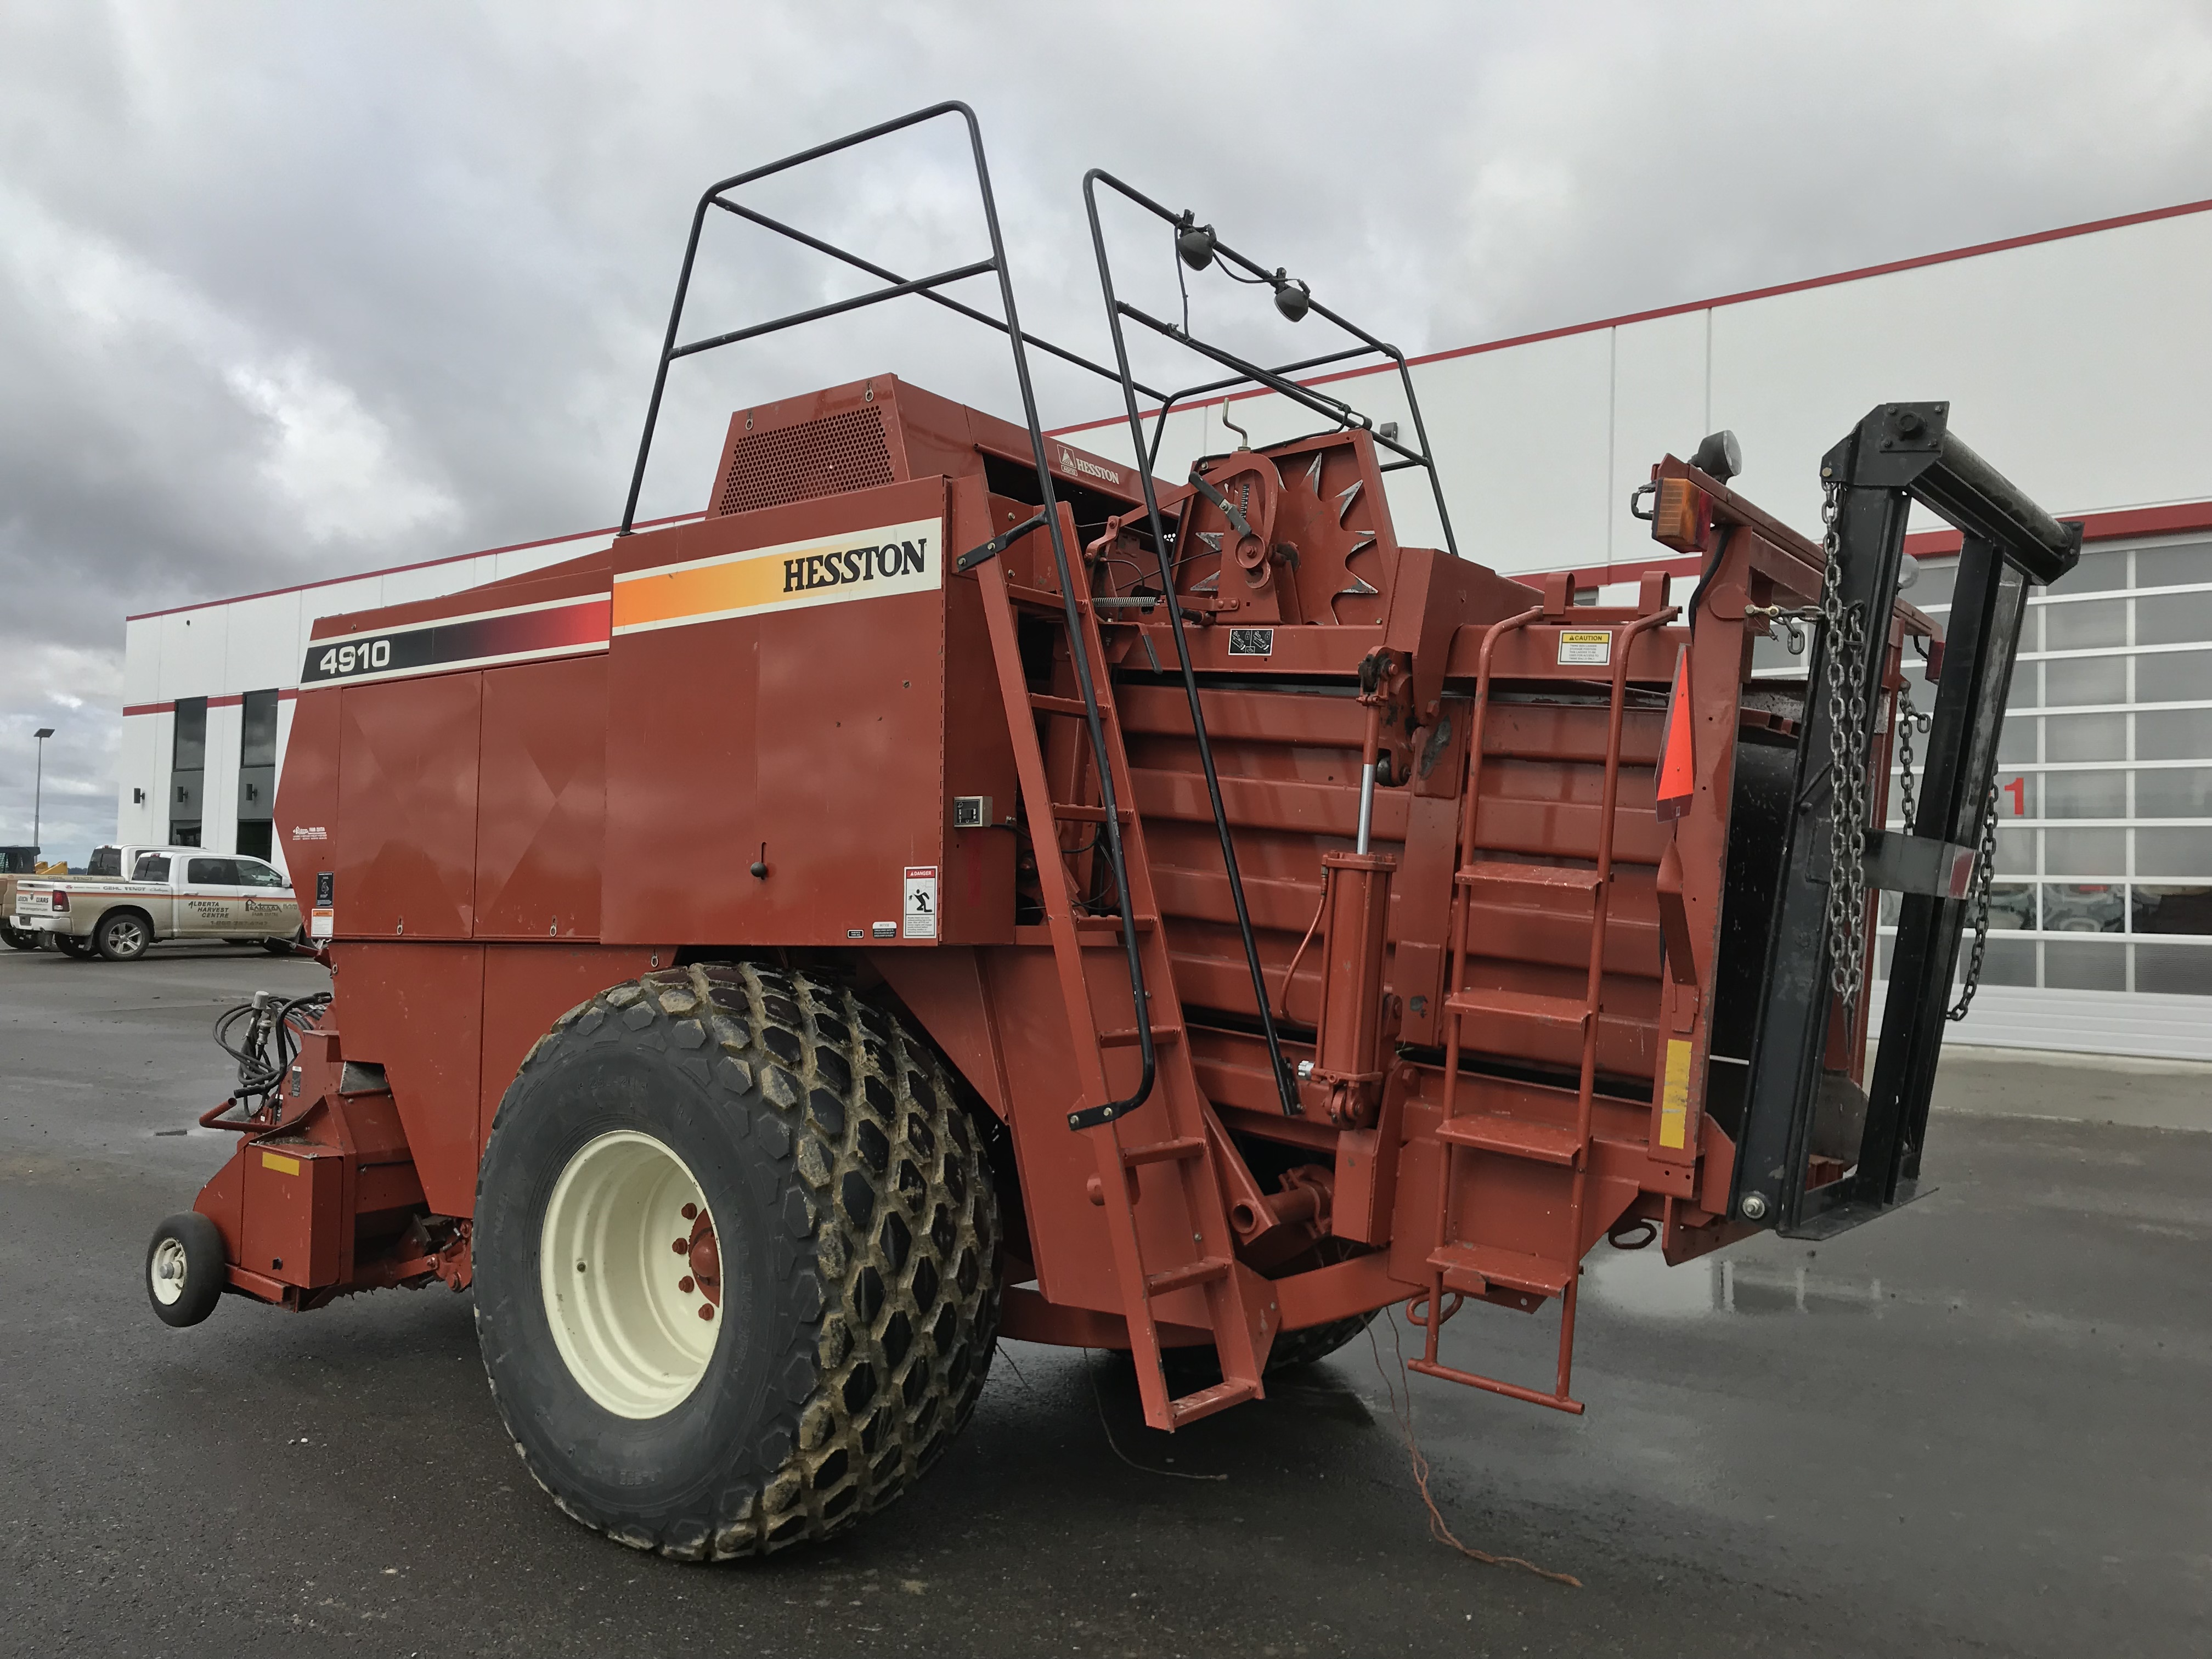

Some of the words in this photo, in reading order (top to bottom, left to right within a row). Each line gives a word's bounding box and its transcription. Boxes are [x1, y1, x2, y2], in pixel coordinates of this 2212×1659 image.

[1076, 458, 1120, 485] HESSTON
[783, 538, 927, 592] HESSTON
[320, 640, 390, 674] 4910
[2004, 777, 2024, 815] 1
